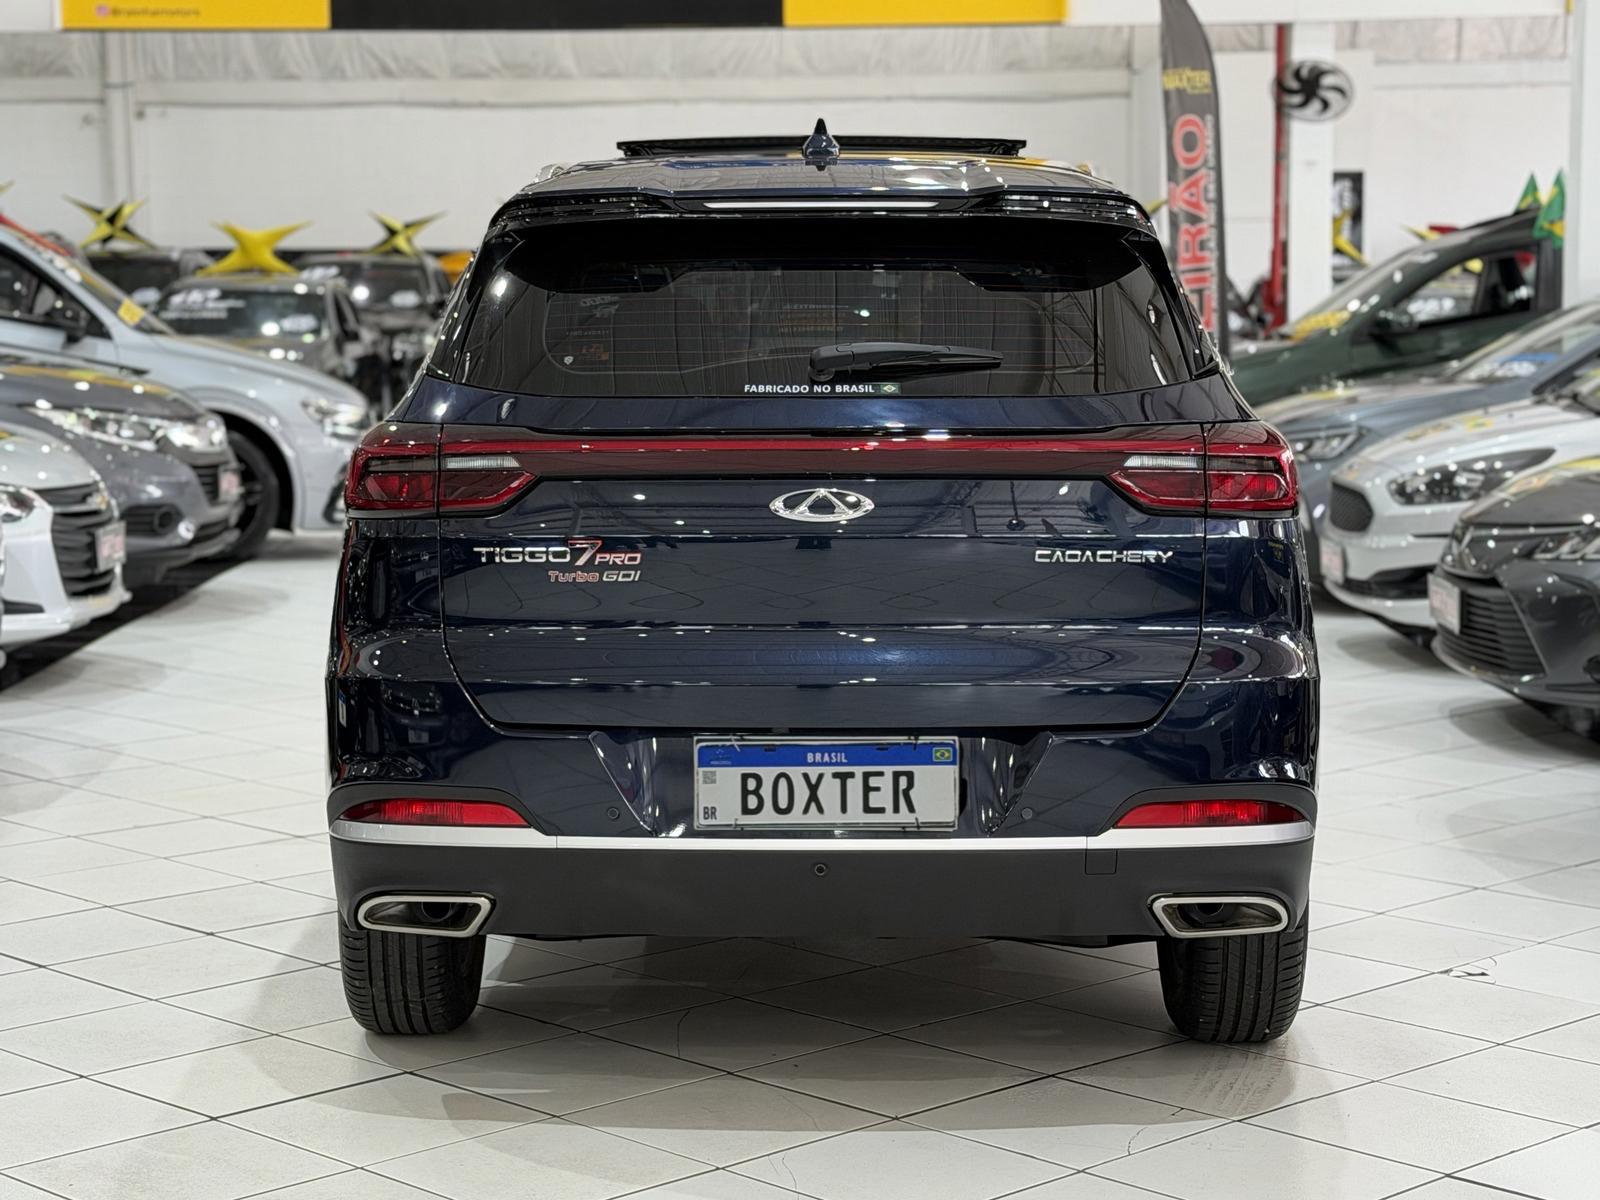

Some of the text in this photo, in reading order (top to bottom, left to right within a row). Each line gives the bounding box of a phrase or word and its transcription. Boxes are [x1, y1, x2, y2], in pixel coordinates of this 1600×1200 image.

[744, 384, 875, 394] FABRICADO NO BRASIL
[1096, 550, 1174, 563] CHERY
[548, 570, 641, 583] Turbo GDI
[806, 752, 848, 763] BRASIL
[740, 770, 917, 816] BOXTER
[703, 806, 718, 821] BR
